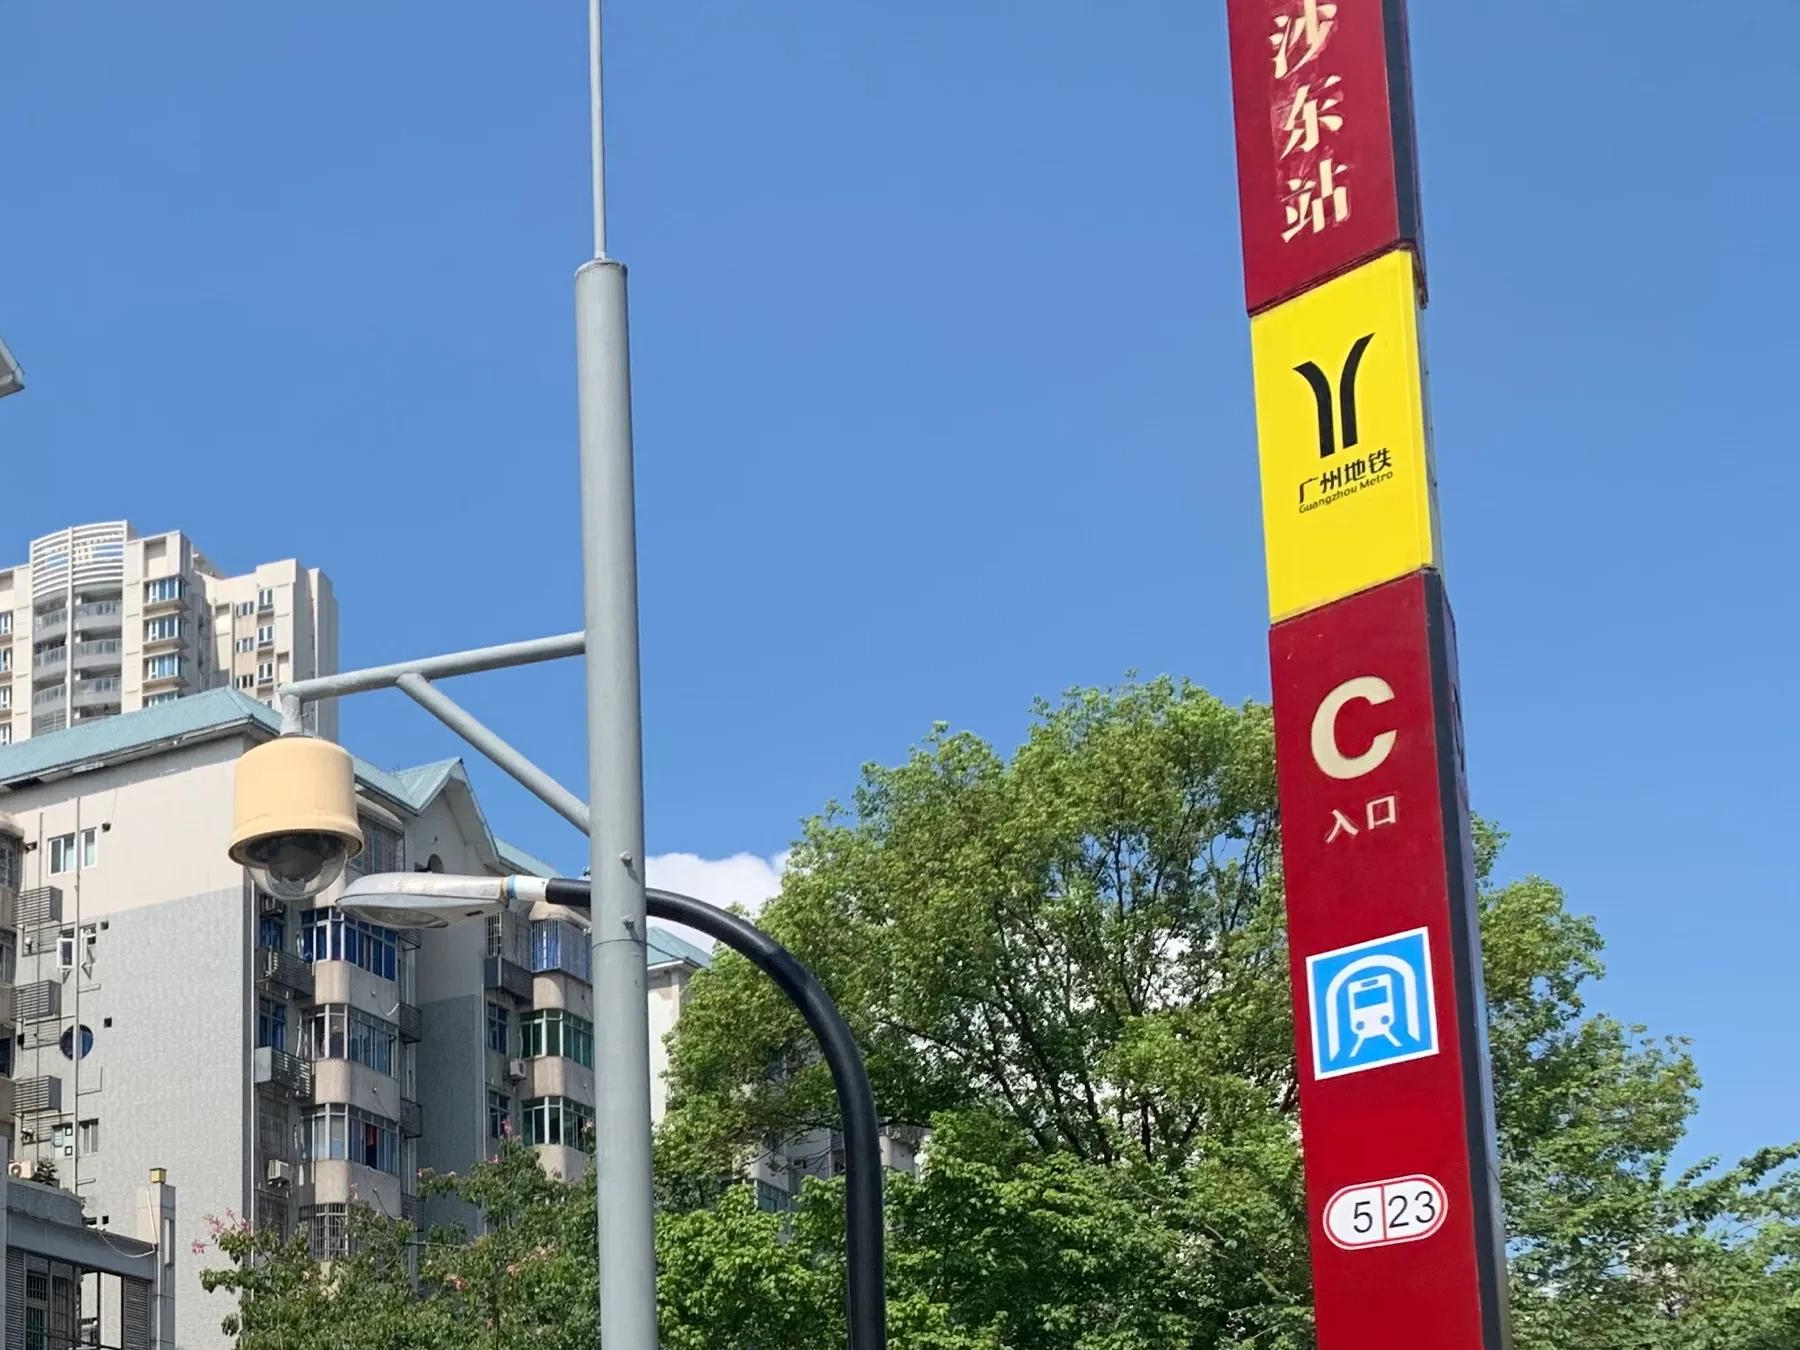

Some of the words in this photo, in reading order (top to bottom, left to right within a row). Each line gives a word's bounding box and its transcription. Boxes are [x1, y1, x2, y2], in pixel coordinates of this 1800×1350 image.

[1299, 447, 1392, 504] 广州地铁
[1299, 484, 1358, 514] Guangzhou
[1360, 471, 1394, 491] Metro
[1310, 675, 1398, 780] C
[1325, 795, 1397, 845] 入口
